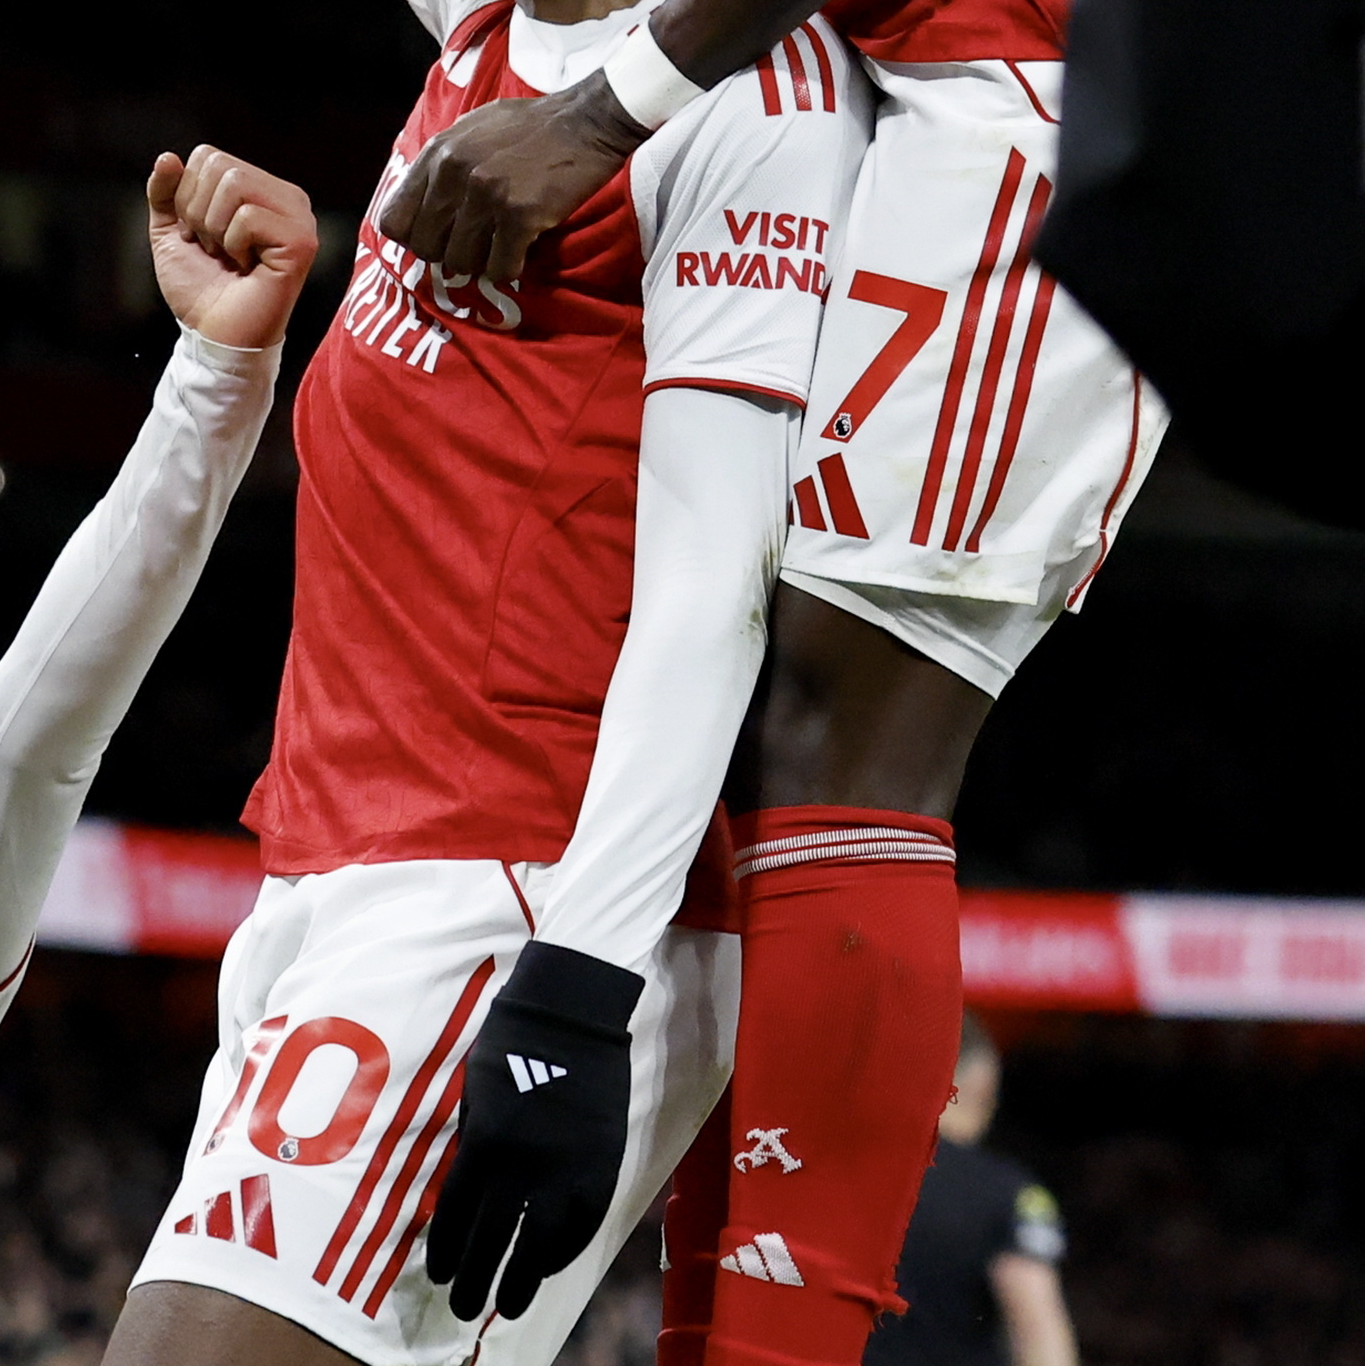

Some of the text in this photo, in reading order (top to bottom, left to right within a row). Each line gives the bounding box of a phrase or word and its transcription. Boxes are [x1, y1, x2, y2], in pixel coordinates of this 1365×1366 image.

[676, 251, 827, 298] RWAND
[723, 209, 829, 255] VISIT
[821, 269, 947, 443] 7
[201, 1013, 391, 1166] 10
